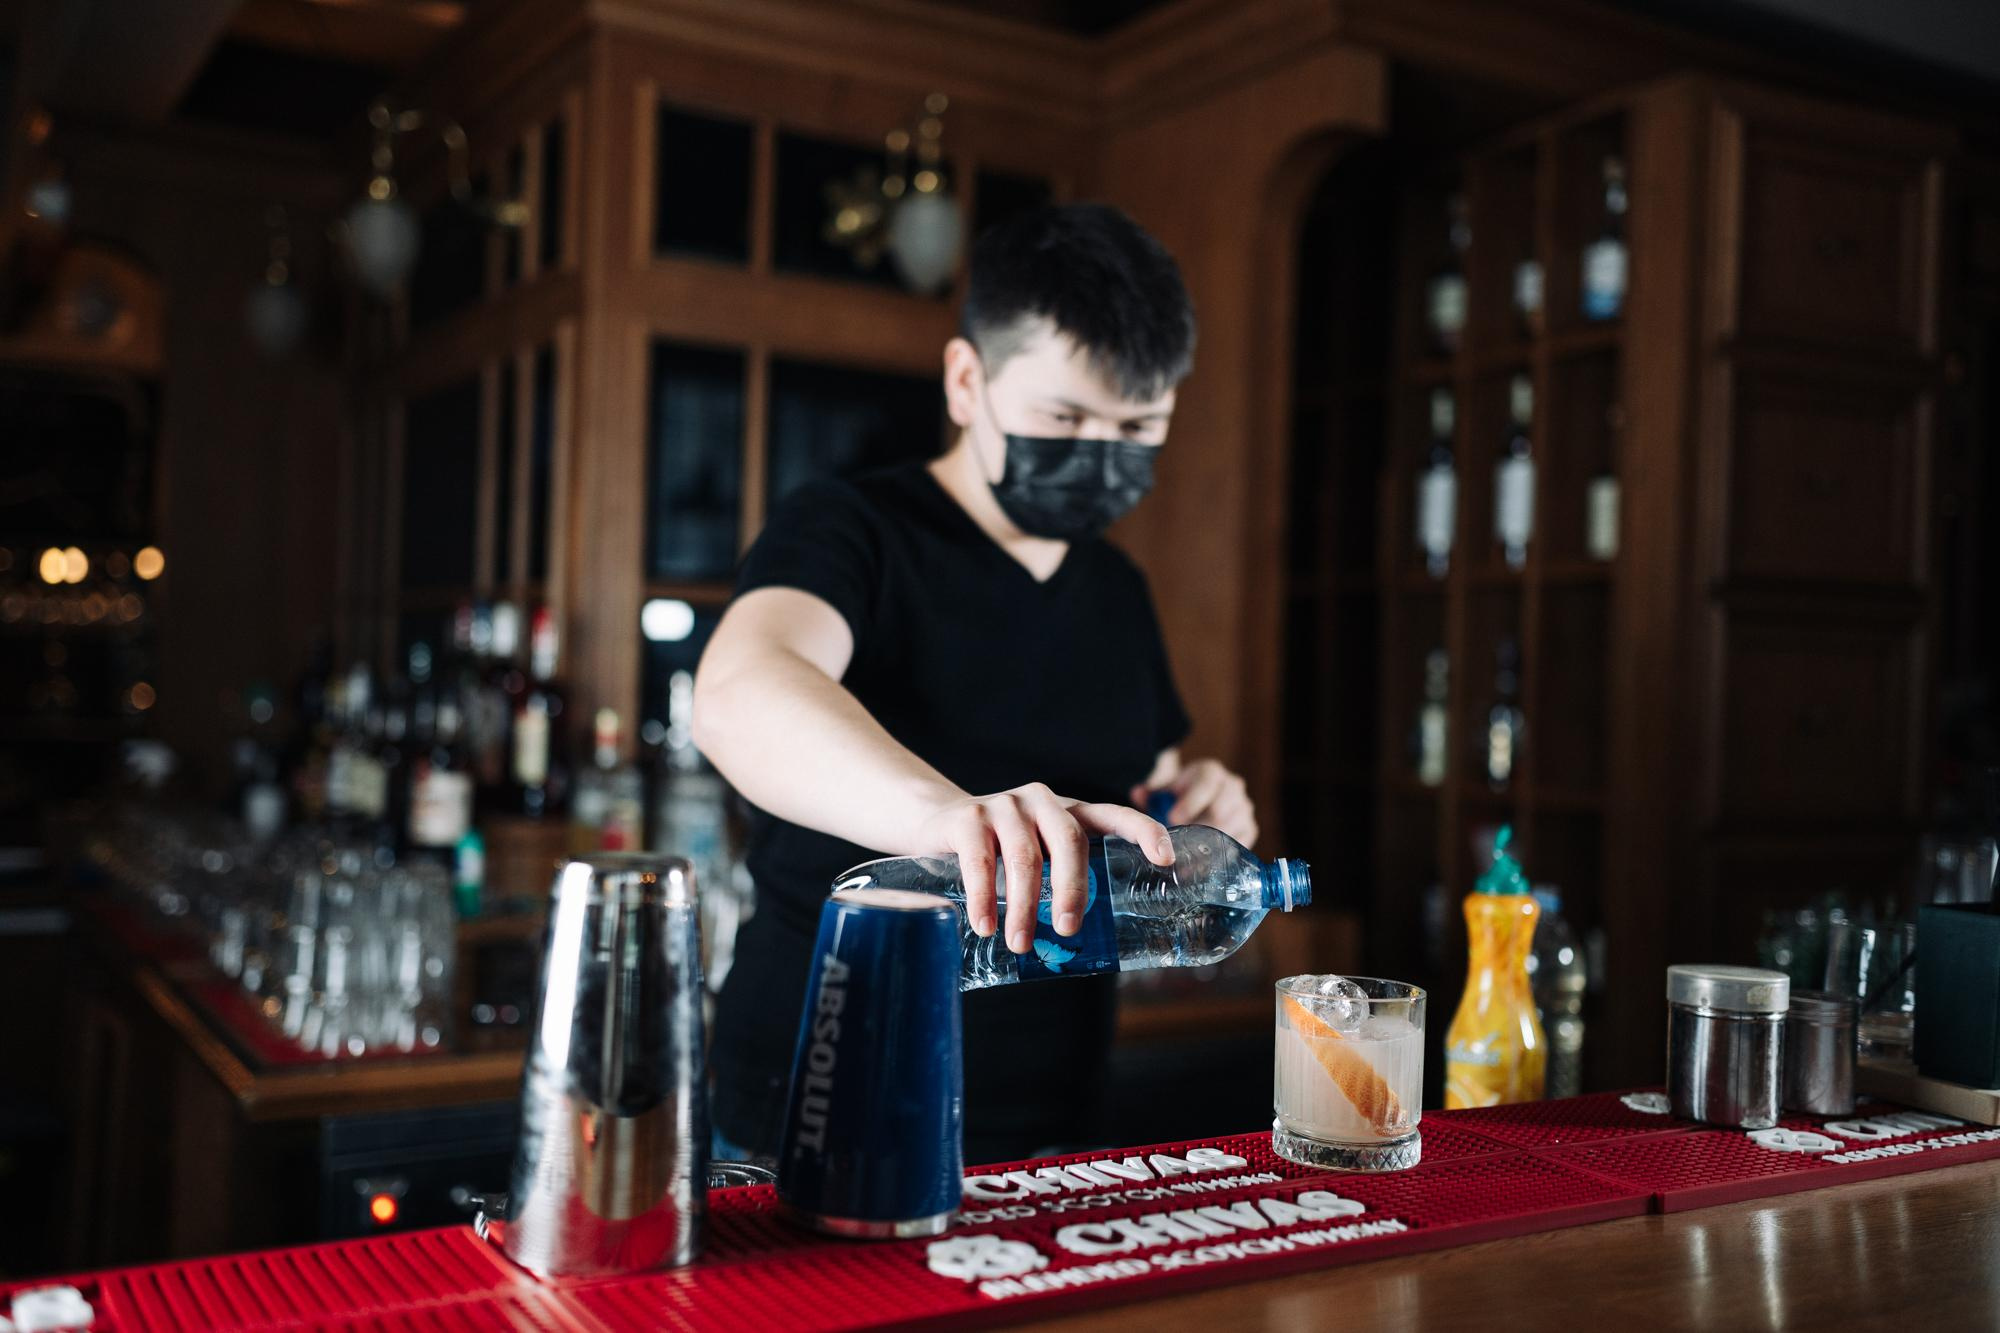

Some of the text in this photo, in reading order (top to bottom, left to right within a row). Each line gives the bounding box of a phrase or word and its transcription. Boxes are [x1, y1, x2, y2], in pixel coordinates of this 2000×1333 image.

[962, 1147, 1248, 1200] CHIVAS
[1041, 1186, 1175, 1212] SCOTCH
[1171, 1171, 1283, 1193] WHISKY
[1055, 1190, 1366, 1256] CHIVAS
[1150, 1235, 1296, 1270] SCOTCH
[1289, 1218, 1408, 1246] WHISKY
